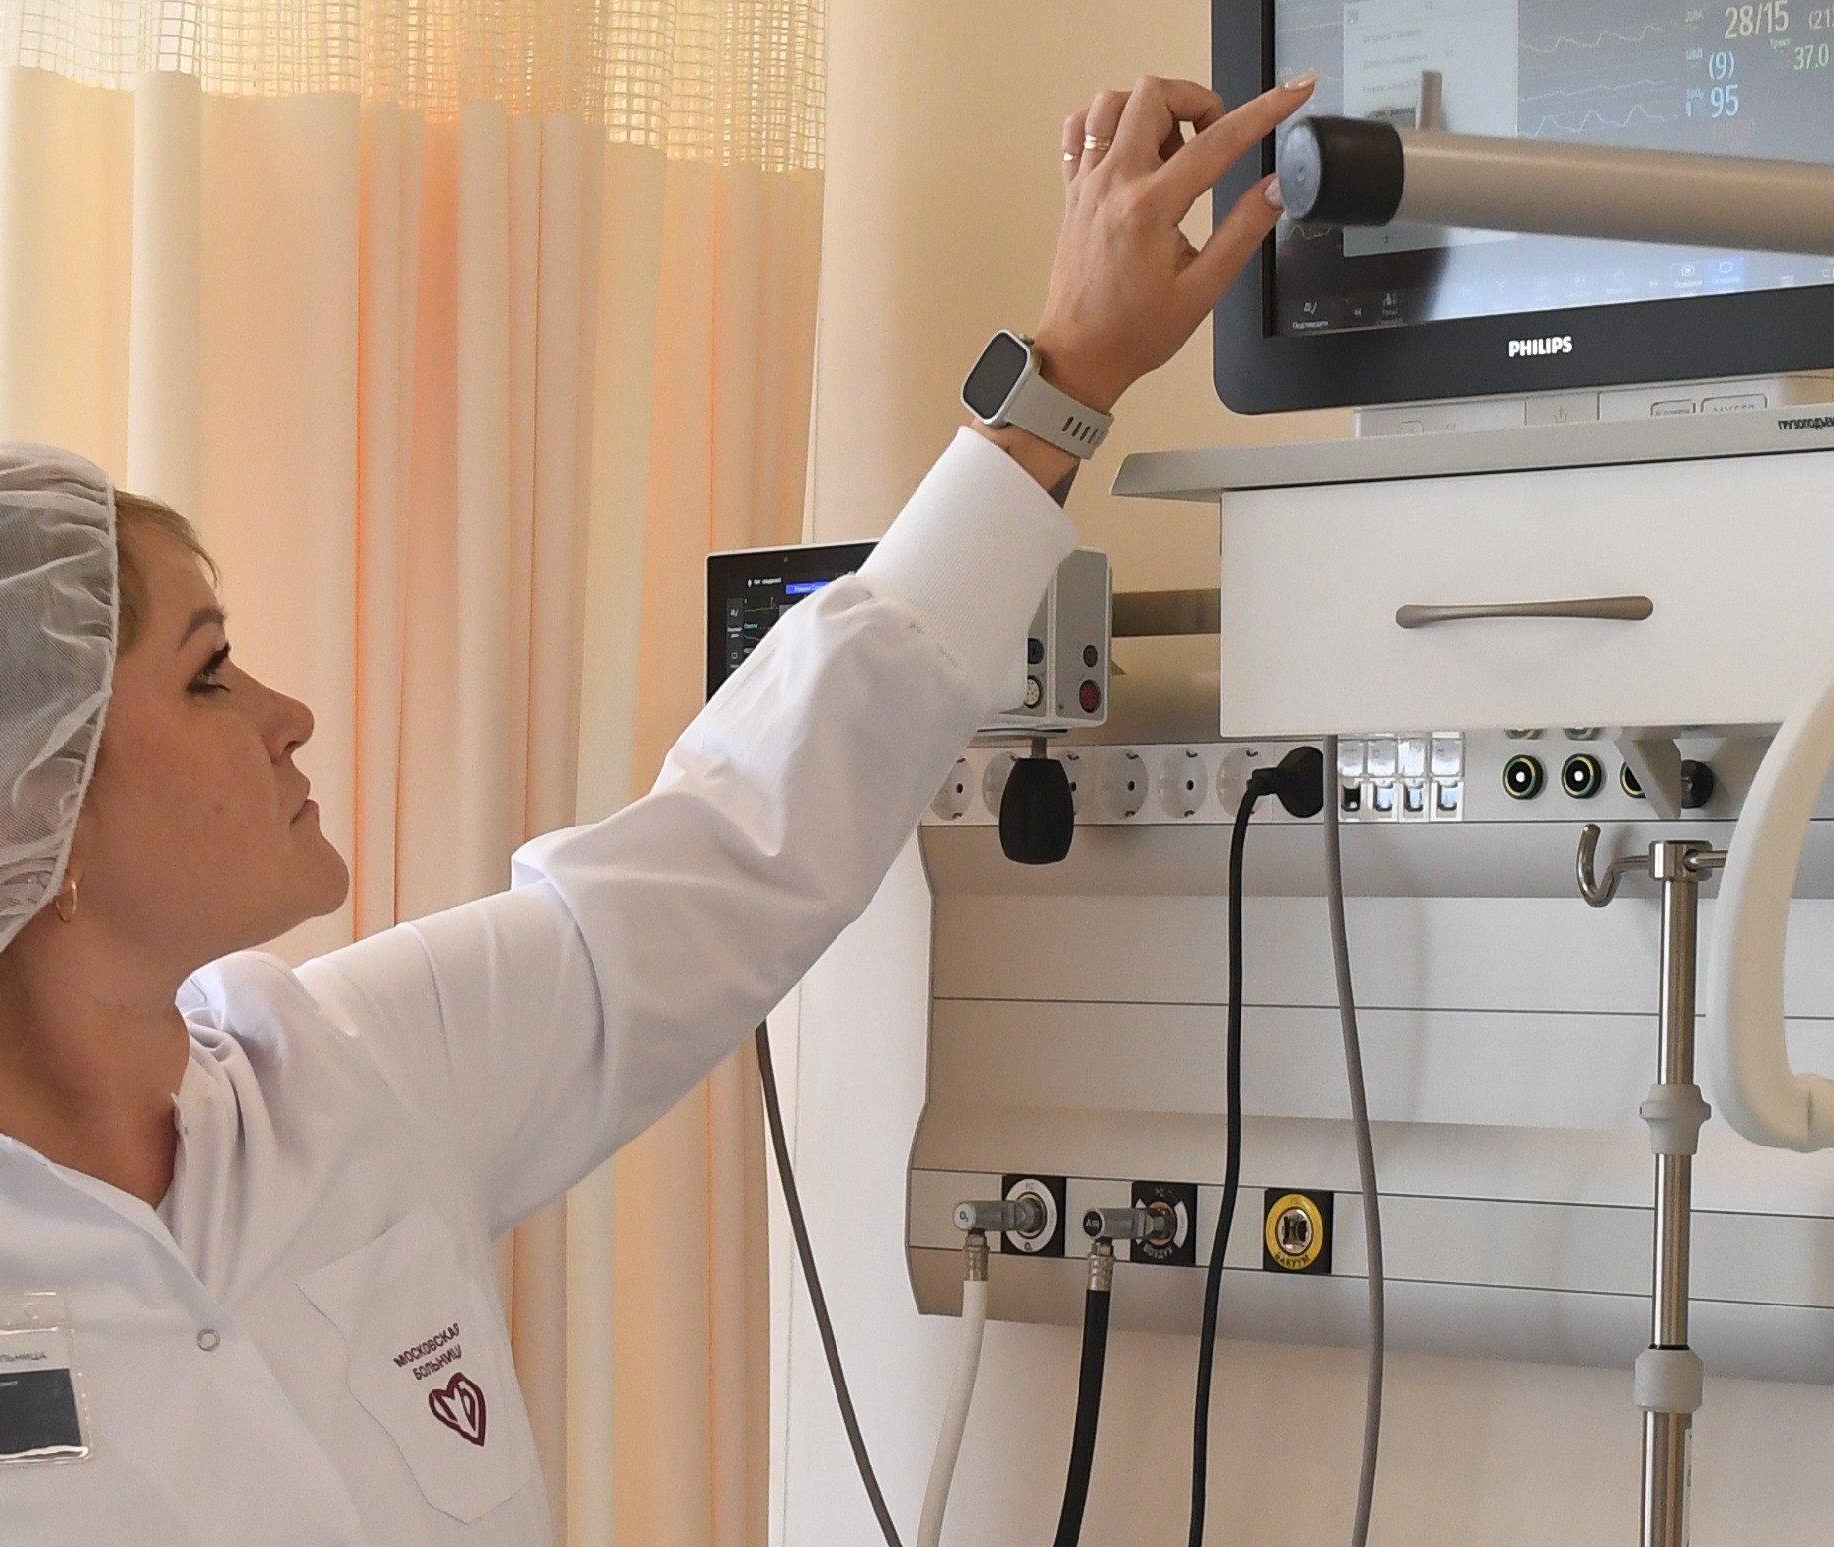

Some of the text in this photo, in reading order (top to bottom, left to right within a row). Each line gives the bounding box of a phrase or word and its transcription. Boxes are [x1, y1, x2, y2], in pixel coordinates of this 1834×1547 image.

[1724, 0, 1789, 39] 28/15
[1708, 50, 1735, 81] (9)
[1793, 43, 1829, 71] 37.0
[1710, 84, 1739, 119] 95
[1508, 335, 1573, 358] PHILIPS
[392, 1322, 460, 1368] МОСКОВСКАЯ
[412, 1343, 462, 1381] БОЛЬНИЦ
